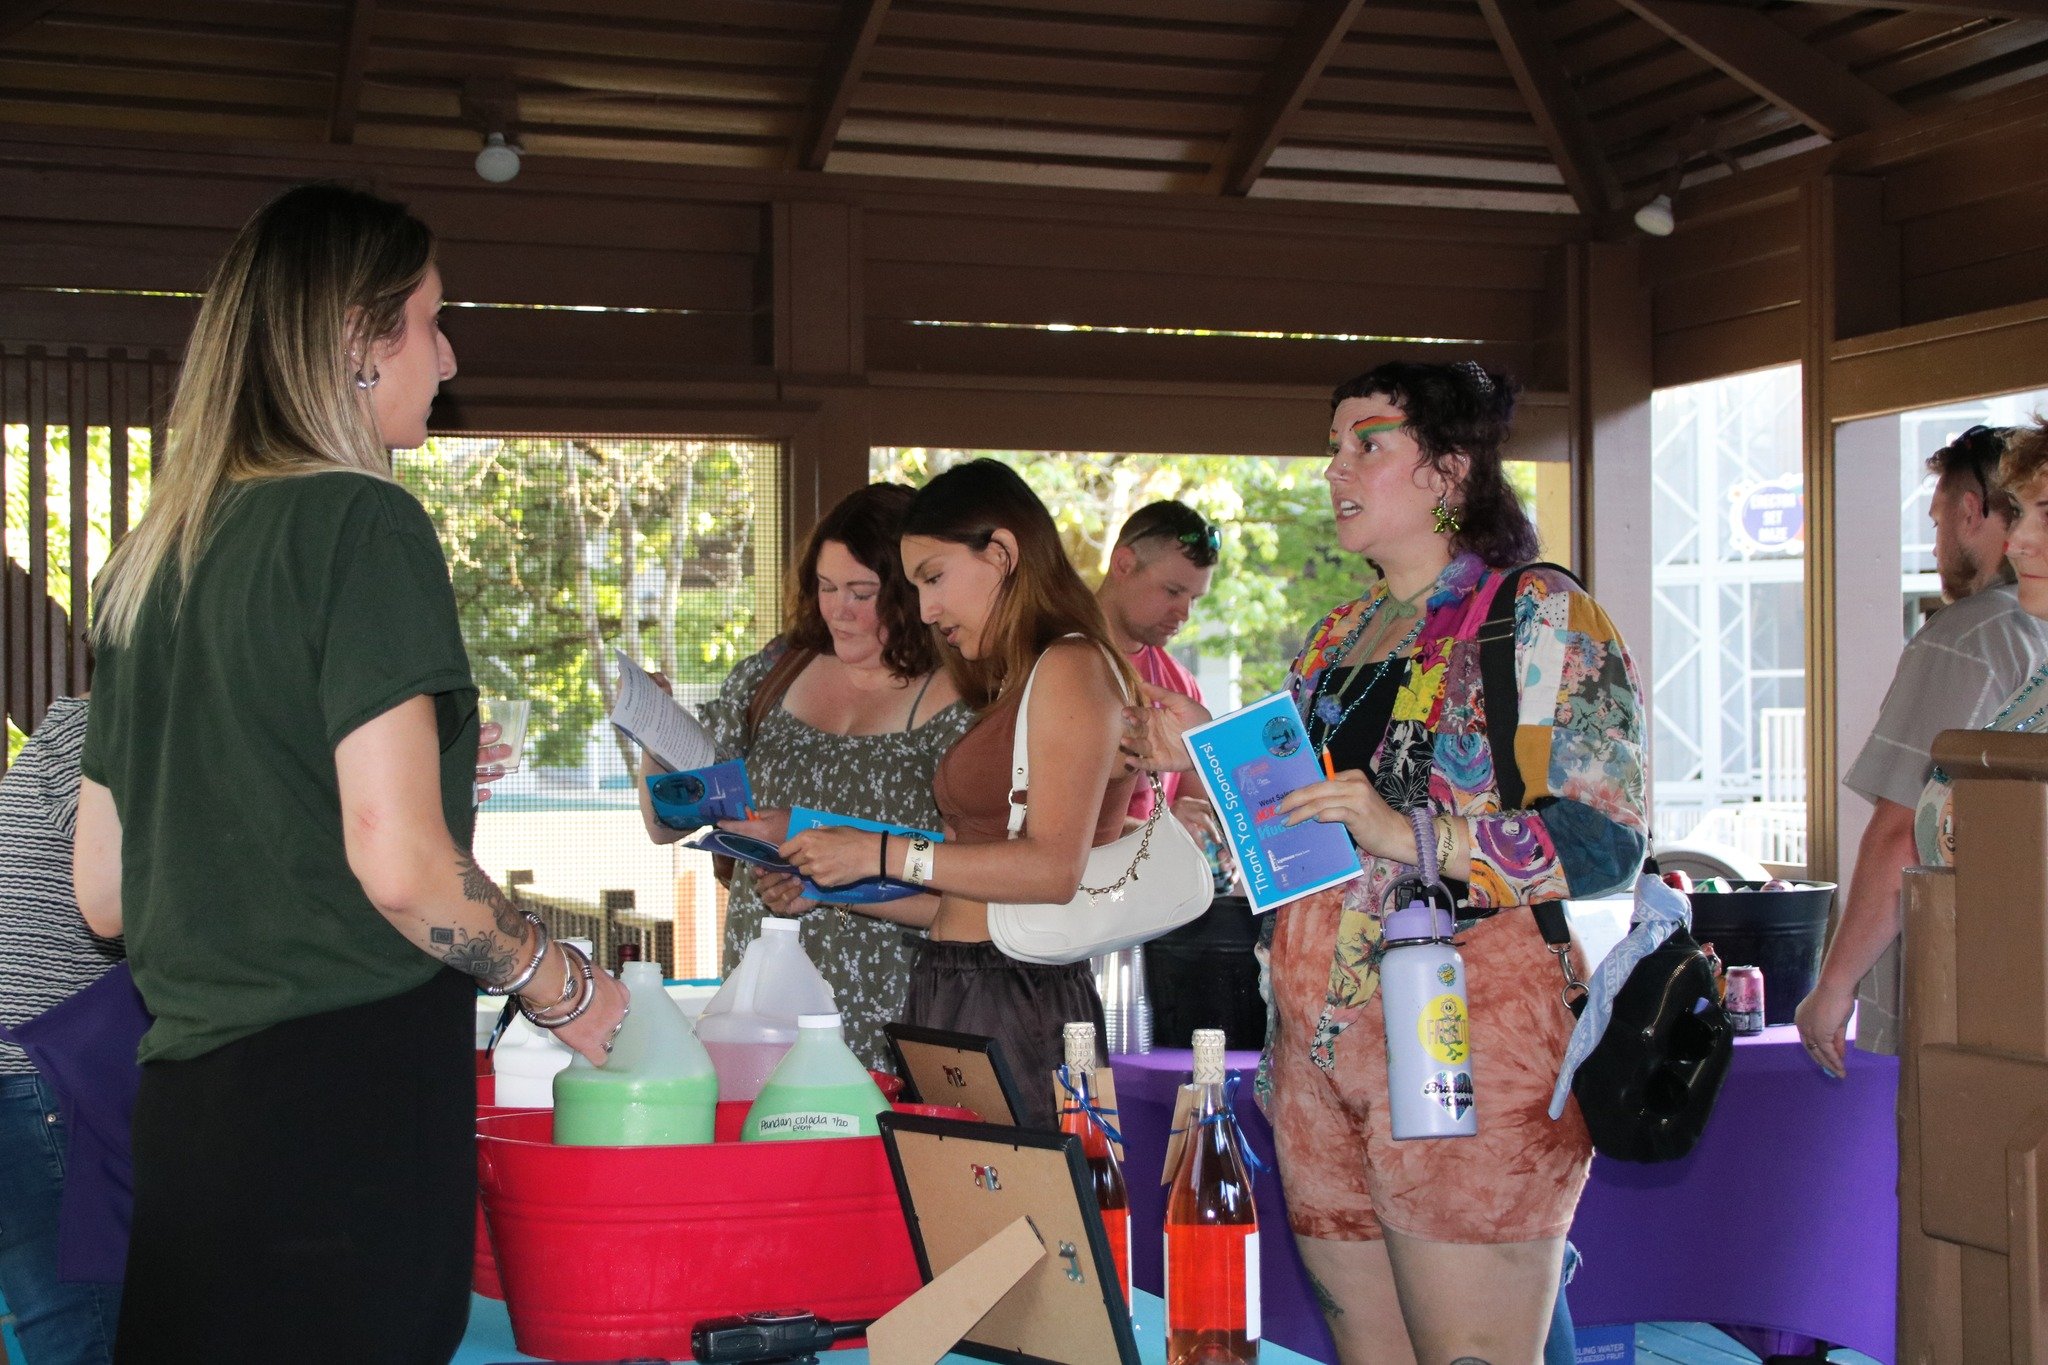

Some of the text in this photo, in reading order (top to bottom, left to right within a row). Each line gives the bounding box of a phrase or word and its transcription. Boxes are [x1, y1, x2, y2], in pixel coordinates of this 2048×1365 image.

[1258, 796, 1276, 807] West
[1198, 742, 1268, 895] Thank You Sponsors!
[760, 1117, 792, 1130] Pandan
[832, 1117, 849, 1127] 7/20
[1597, 1343, 1624, 1353] WATER
[1606, 1352, 1624, 1360] FRUIT
